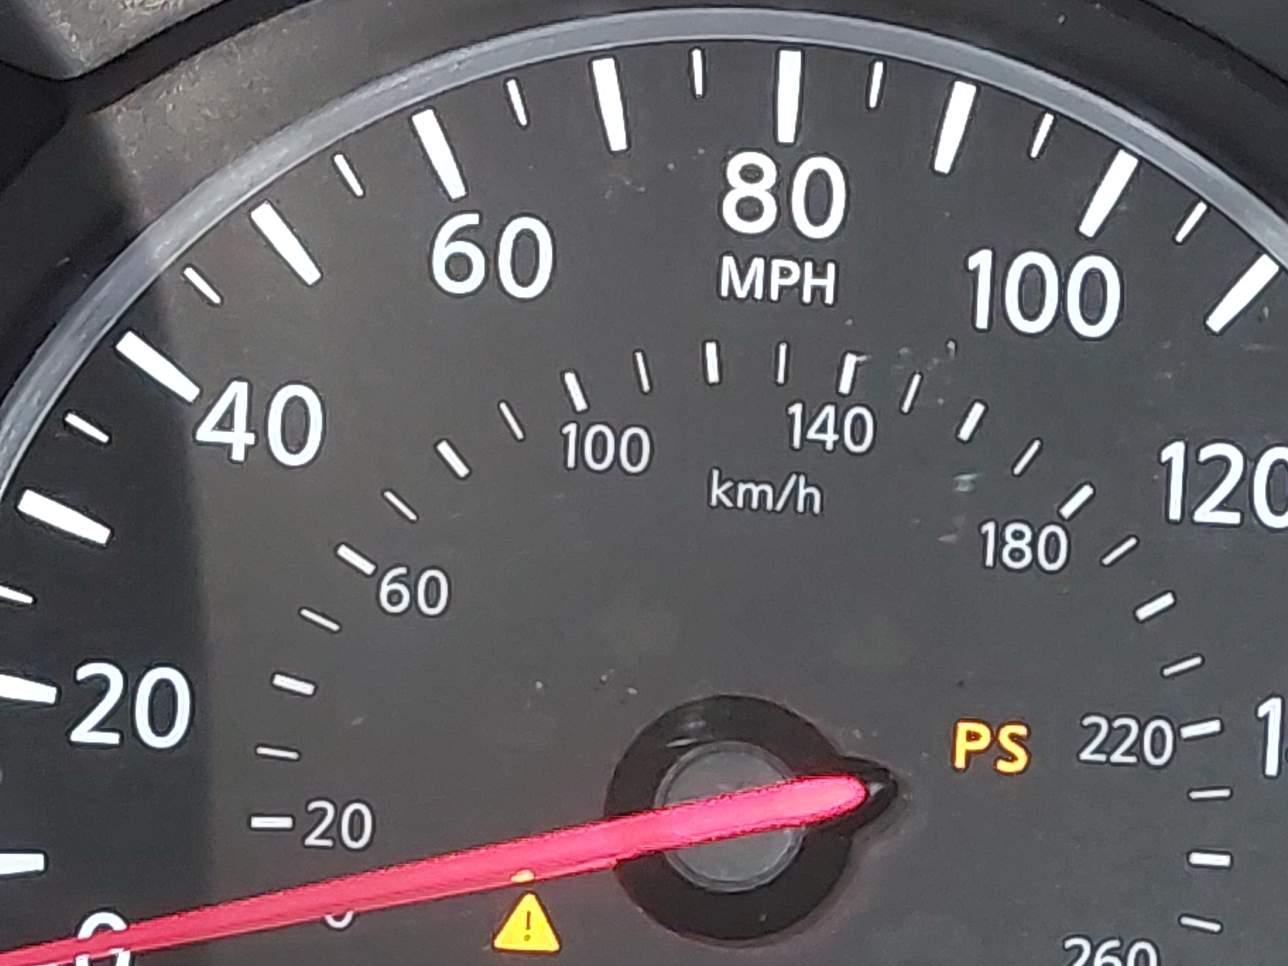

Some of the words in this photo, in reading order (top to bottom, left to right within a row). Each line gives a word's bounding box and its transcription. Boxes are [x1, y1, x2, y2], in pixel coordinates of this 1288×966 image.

[723, 152, 845, 238] 80
[432, 214, 552, 298] 60
[721, 256, 835, 304] MPH
[967, 249, 1121, 338] 100
[195, 381, 323, 465] 40
[561, 422, 651, 473] 100
[787, 402, 874, 453] 140
[709, 469, 821, 515] km/h
[980, 520, 1070, 571] 180
[379, 566, 449, 616] 60
[71, 663, 190, 748] 20
[953, 720, 1030, 774] PS
[1079, 716, 1174, 766] 220
[304, 800, 372, 849] 20
